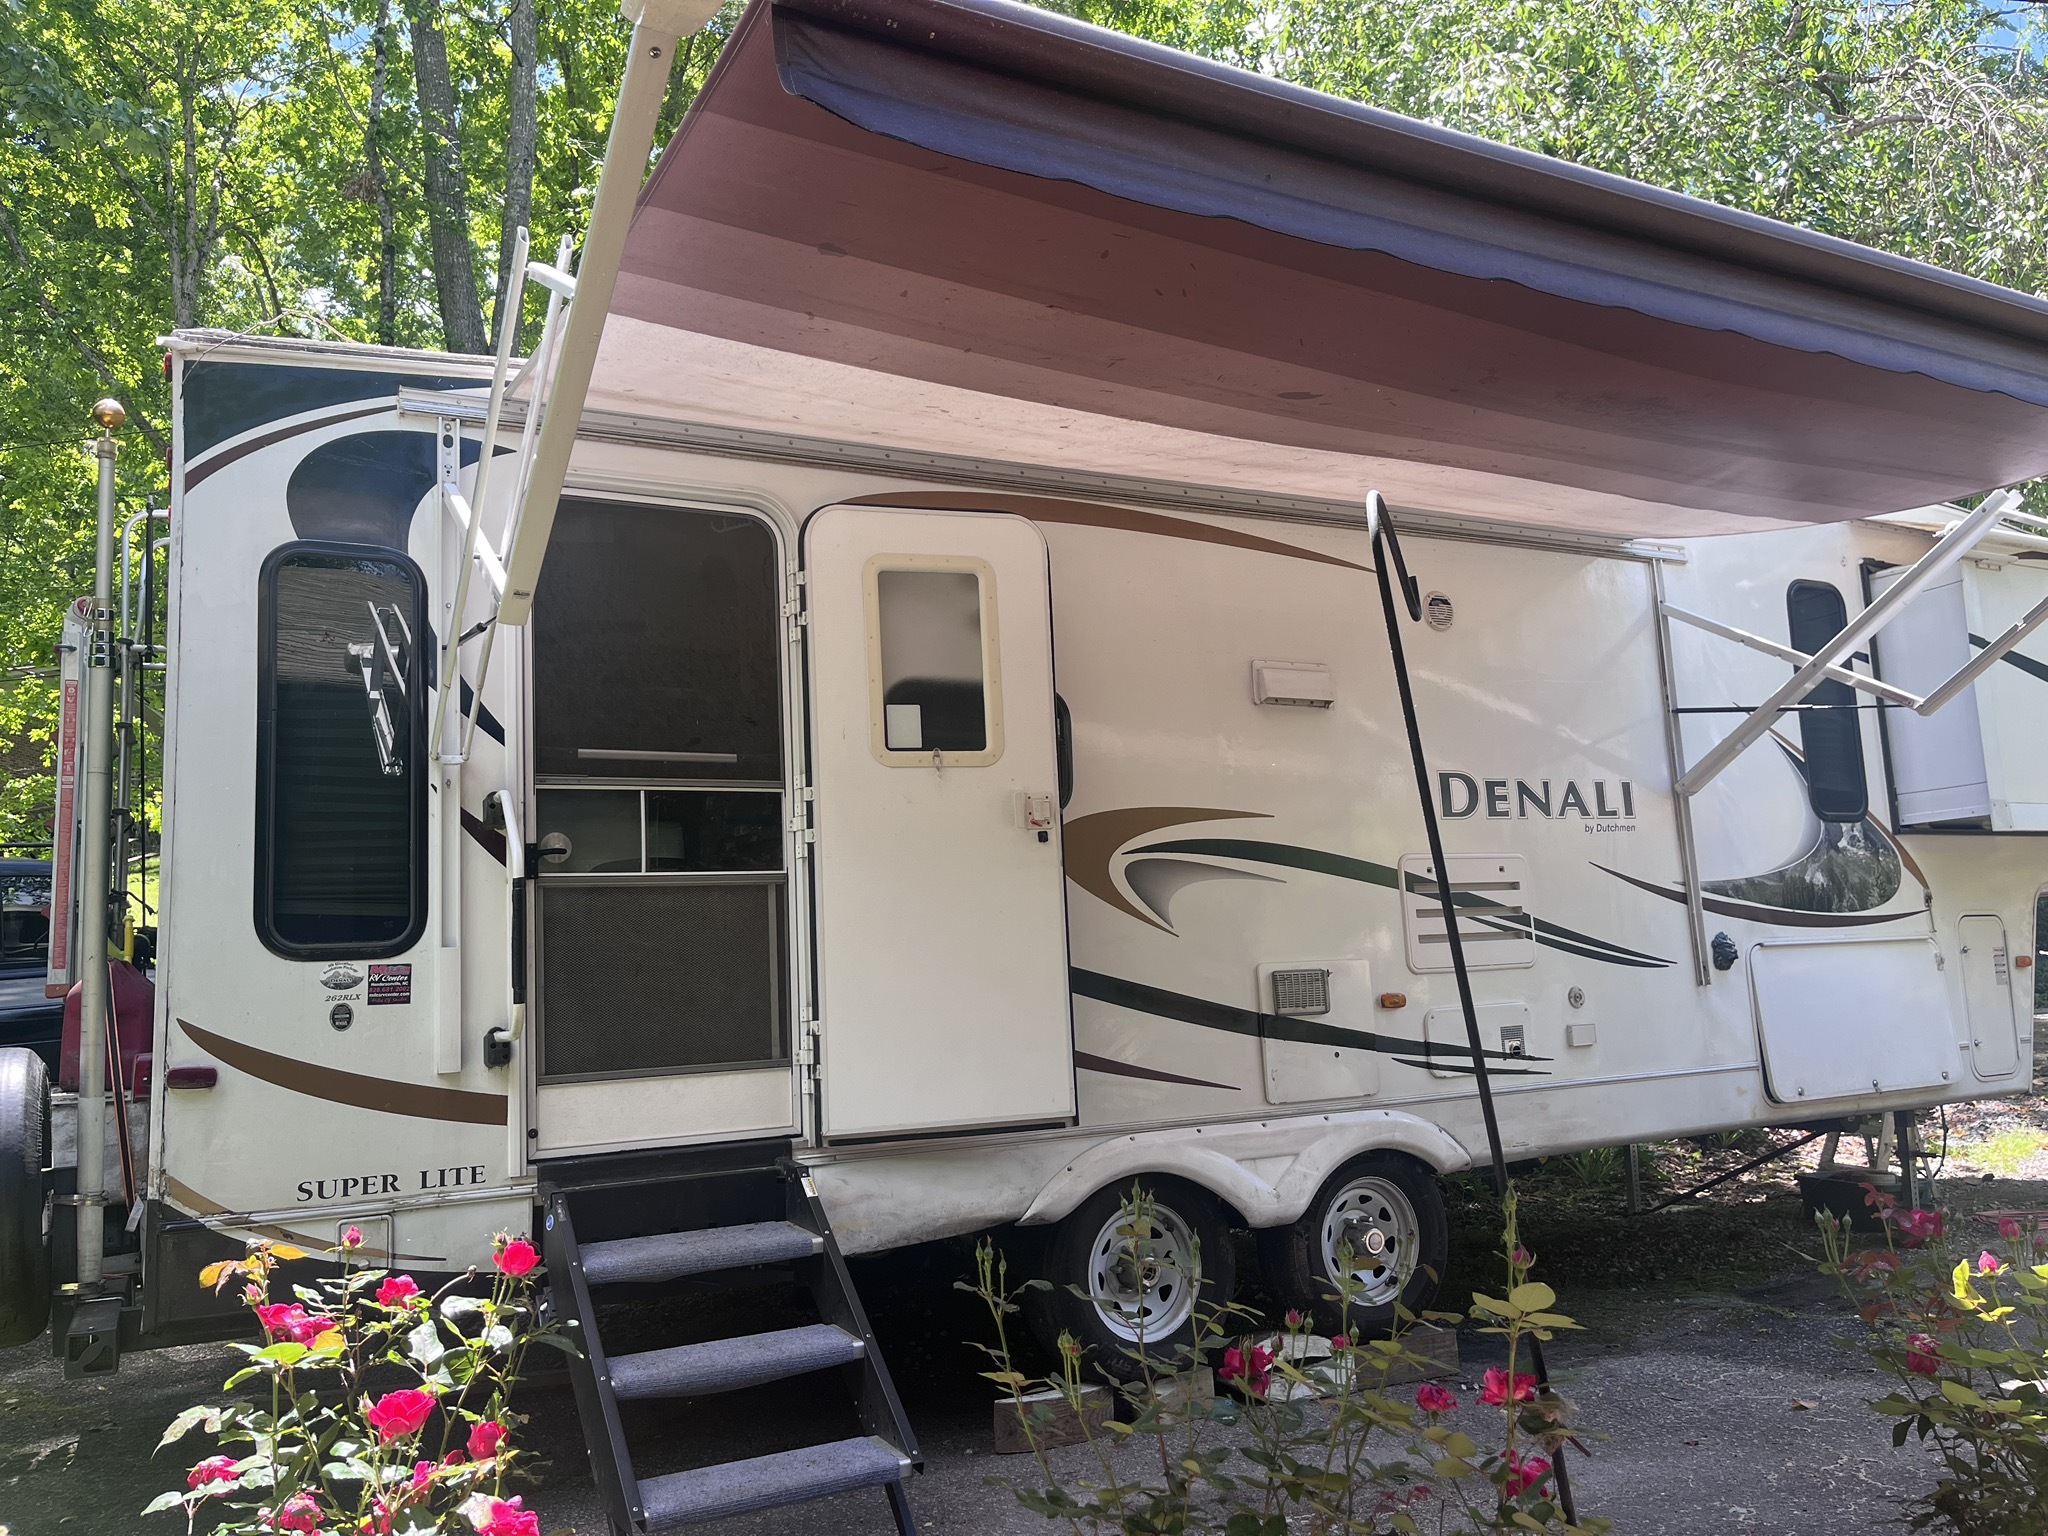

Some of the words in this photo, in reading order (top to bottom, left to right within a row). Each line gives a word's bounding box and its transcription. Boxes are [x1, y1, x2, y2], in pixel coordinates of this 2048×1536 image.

[1437, 770, 1636, 821] DENALI
[1585, 824, 1595, 834] by
[1596, 823, 1636, 833] Dutchmen
[369, 973, 384, 982] RV
[325, 994, 362, 1002] 262RLX
[297, 1174, 401, 1202] SUPER
[420, 1165, 487, 1190] LITE
